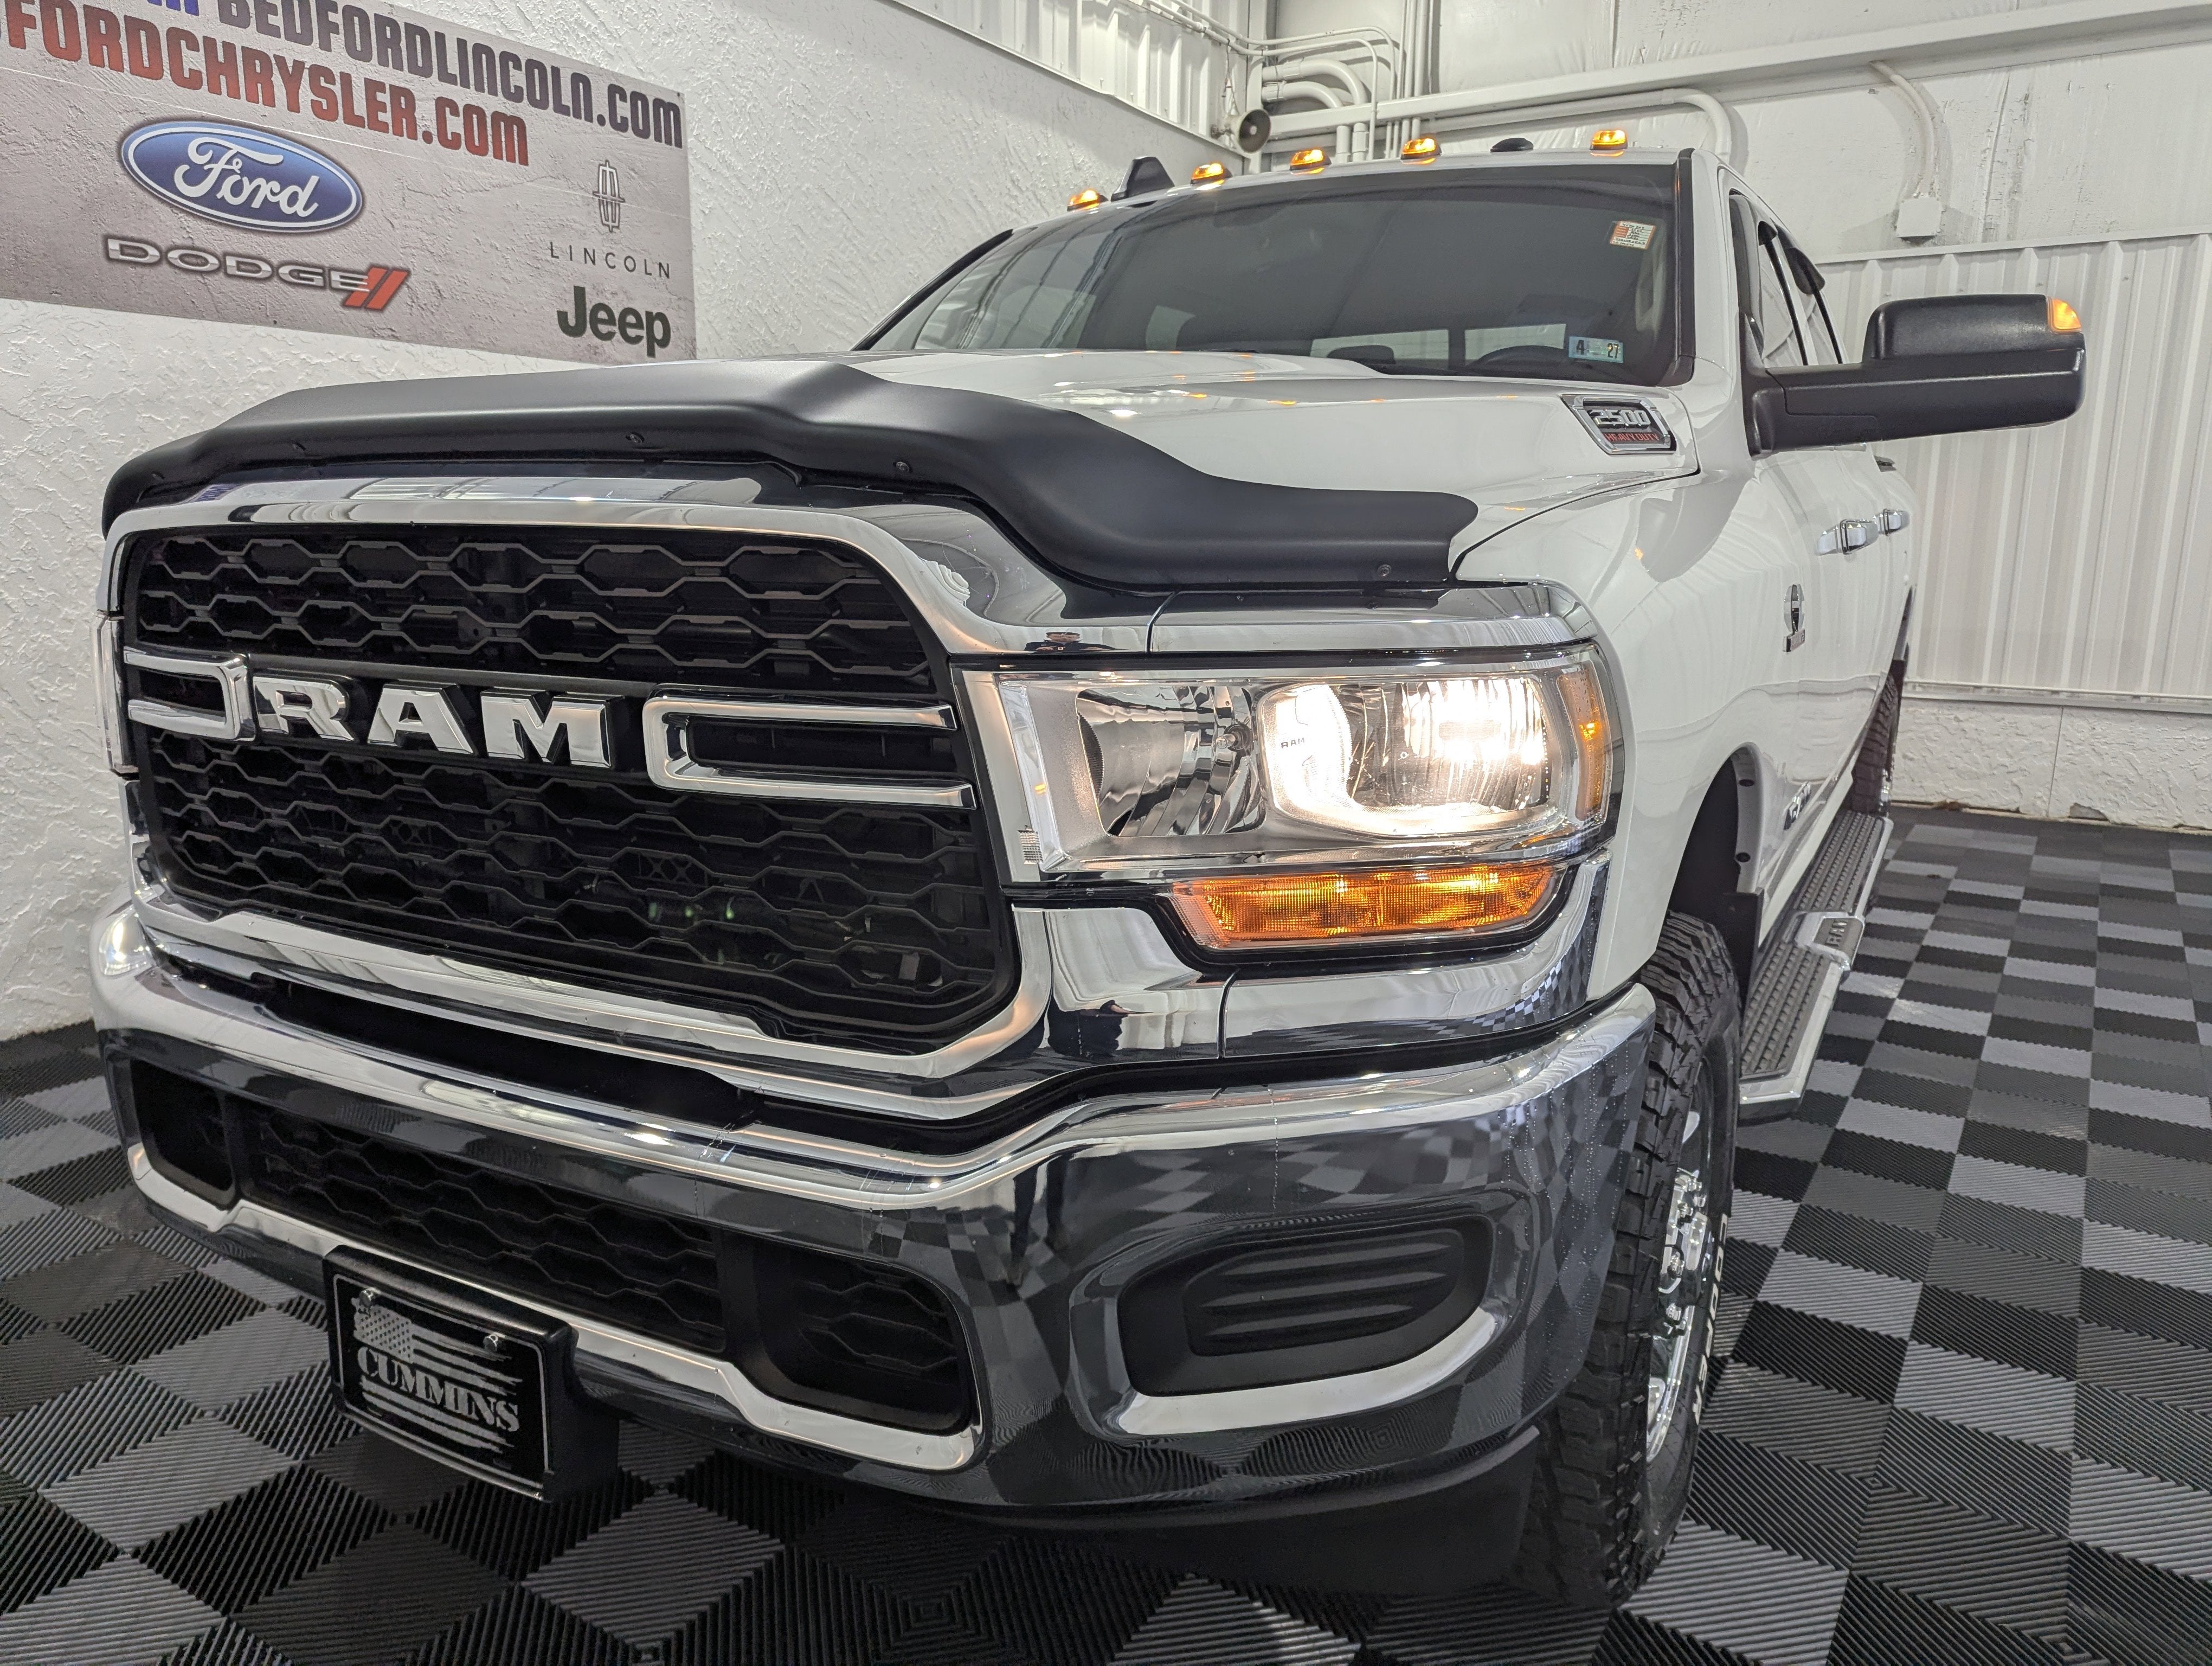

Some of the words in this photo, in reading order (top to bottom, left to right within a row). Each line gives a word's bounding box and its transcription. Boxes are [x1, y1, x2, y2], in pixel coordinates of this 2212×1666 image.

[5, 0, 529, 166] FORDCHRYSLER.COM
[218, 0, 683, 148] BEDFORDLINCOLN.COM
[173, 137, 320, 217] Ford
[107, 238, 370, 292] DODGE
[549, 241, 671, 279] LINCOLN
[556, 285, 672, 358] Jeep
[1607, 343, 1619, 359] 27
[1589, 409, 1651, 427] 2500
[1606, 433, 1637, 441] HEAVY
[253, 675, 613, 769] RAM
[1281, 738, 1304, 748] RAM
[1692, 1213, 1728, 1425] COOPER
[358, 1346, 520, 1432] CUMMINS
